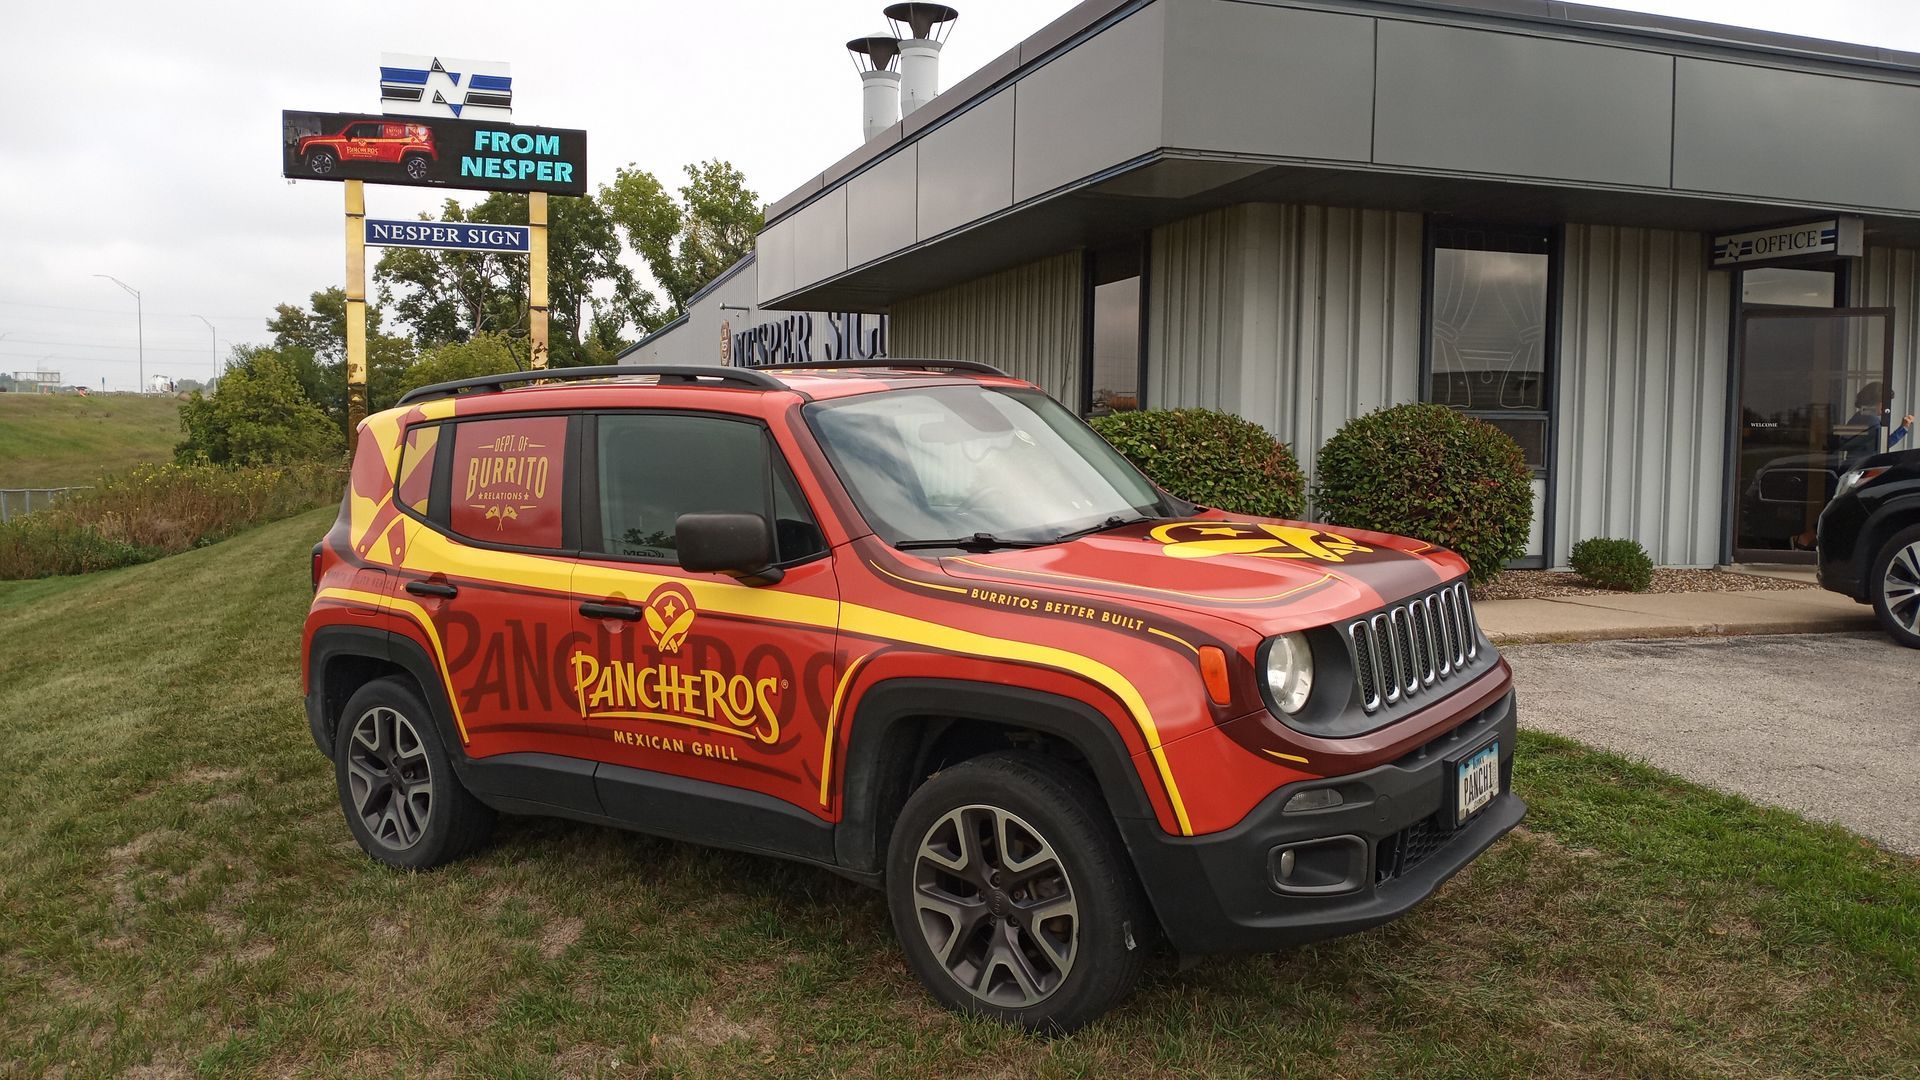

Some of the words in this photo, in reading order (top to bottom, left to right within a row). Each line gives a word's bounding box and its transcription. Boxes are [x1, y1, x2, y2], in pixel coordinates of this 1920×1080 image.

[474, 130, 560, 156] FROM
[460, 156, 573, 183] NESPER
[372, 223, 462, 243] NESPER
[467, 228, 521, 246] SIGN
[1755, 230, 1818, 254] OFFICE
[732, 311, 813, 368] NESPER
[494, 434, 515, 452] DEPT.
[518, 435, 529, 452] OF
[465, 456, 549, 501] BURRITO
[483, 492, 522, 500] RELATIONS
[971, 588, 1039, 610] BURRITOS
[1044, 601, 1095, 620] BETTER
[1101, 611, 1144, 631] BUILT
[571, 650, 779, 745] PANCHEROS
[613, 729, 685, 754] MEXICAN
[692, 741, 739, 762] GRILL
